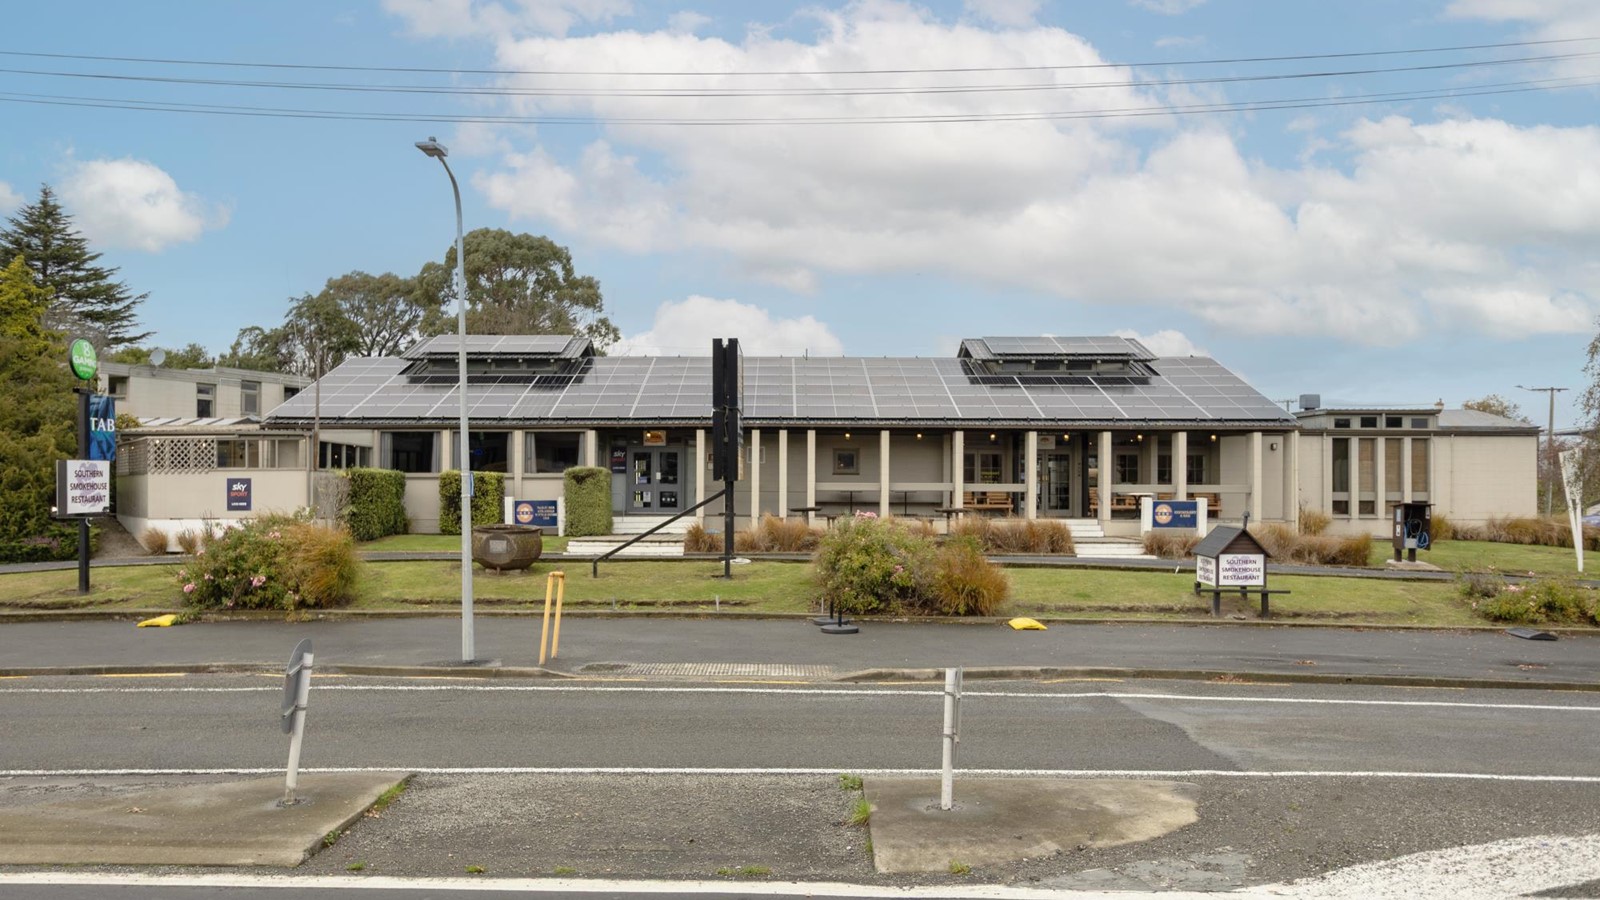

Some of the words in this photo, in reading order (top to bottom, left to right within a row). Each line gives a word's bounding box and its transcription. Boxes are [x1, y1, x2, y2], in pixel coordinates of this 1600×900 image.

[90, 418, 115, 432] TAB
[70, 482, 107, 490] SMOKEHOUSE
[232, 482, 247, 492] sky
[71, 495, 106, 504] RESTAURANT
